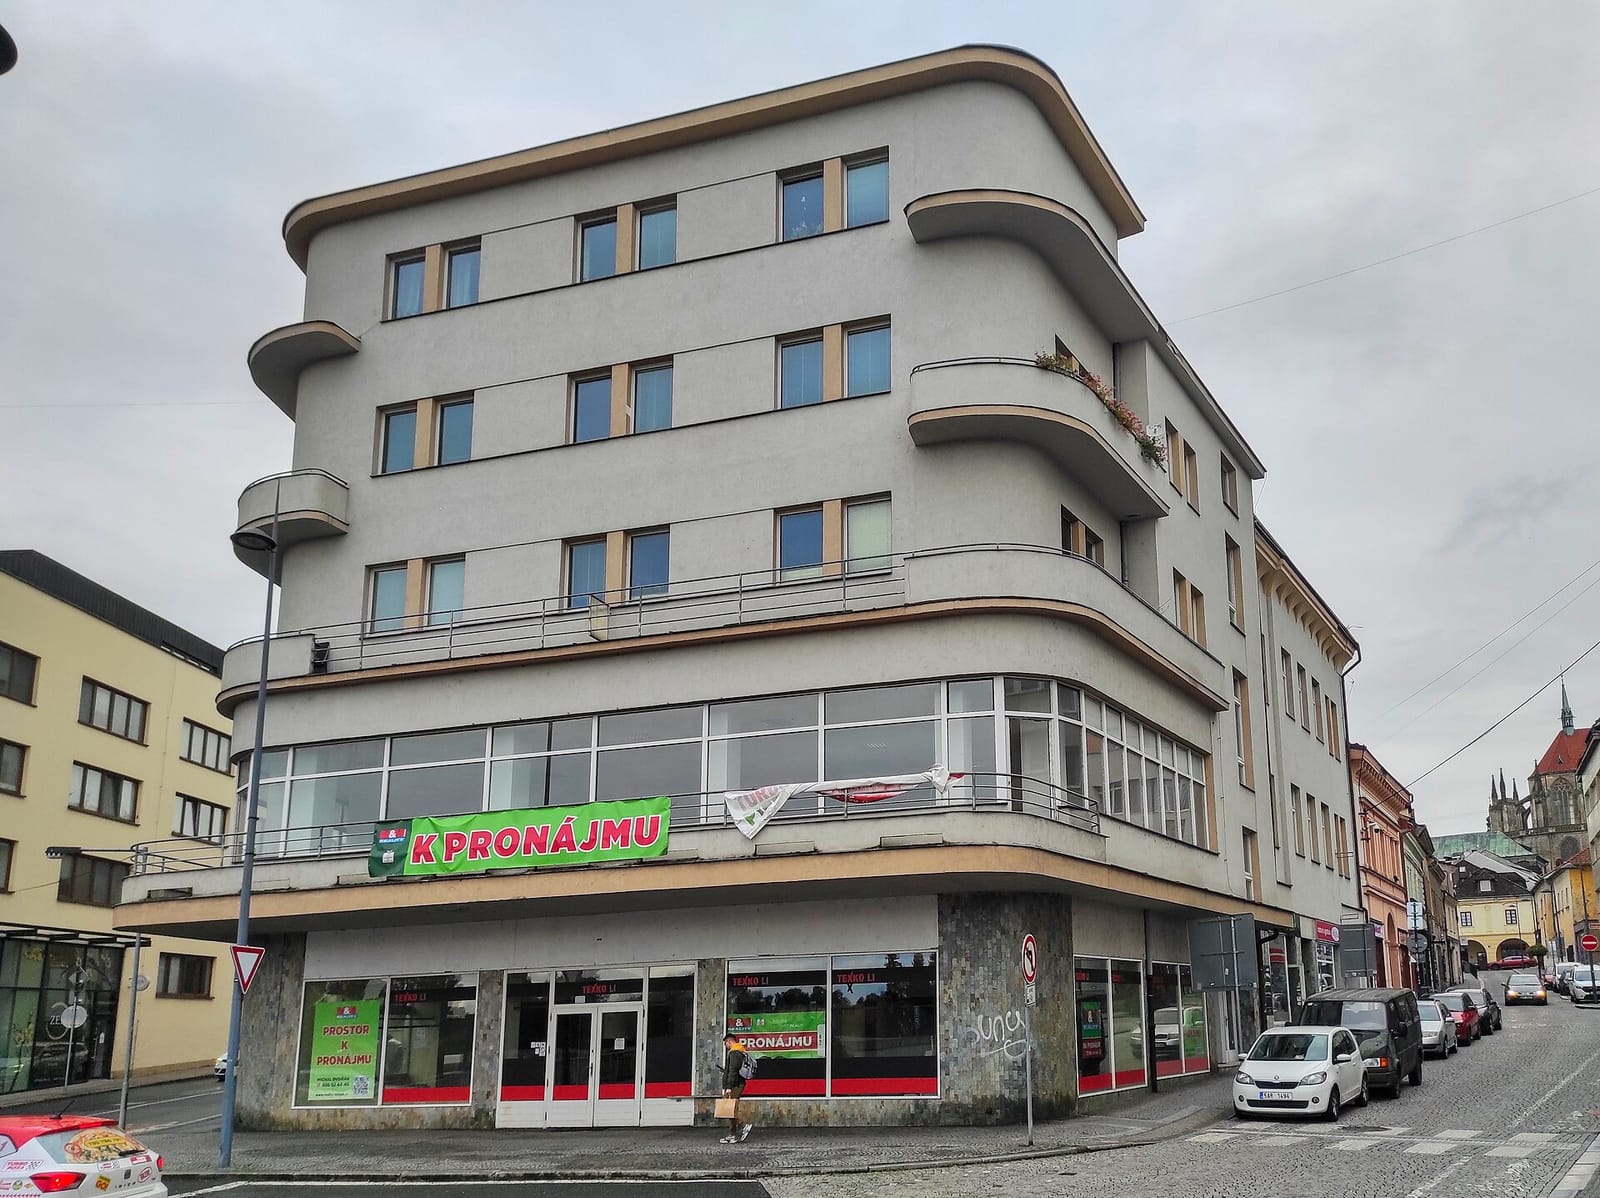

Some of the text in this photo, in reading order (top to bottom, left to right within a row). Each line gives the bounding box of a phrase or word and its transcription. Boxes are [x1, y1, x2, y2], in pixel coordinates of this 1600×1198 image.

[411, 816, 661, 864] K PRONÁJMU
[323, 1025, 370, 1036] PROSTOR
[341, 1040, 349, 1050] K
[738, 1034, 812, 1049] PRONÁJMU
[317, 1053, 372, 1066] PRONÁJMU
